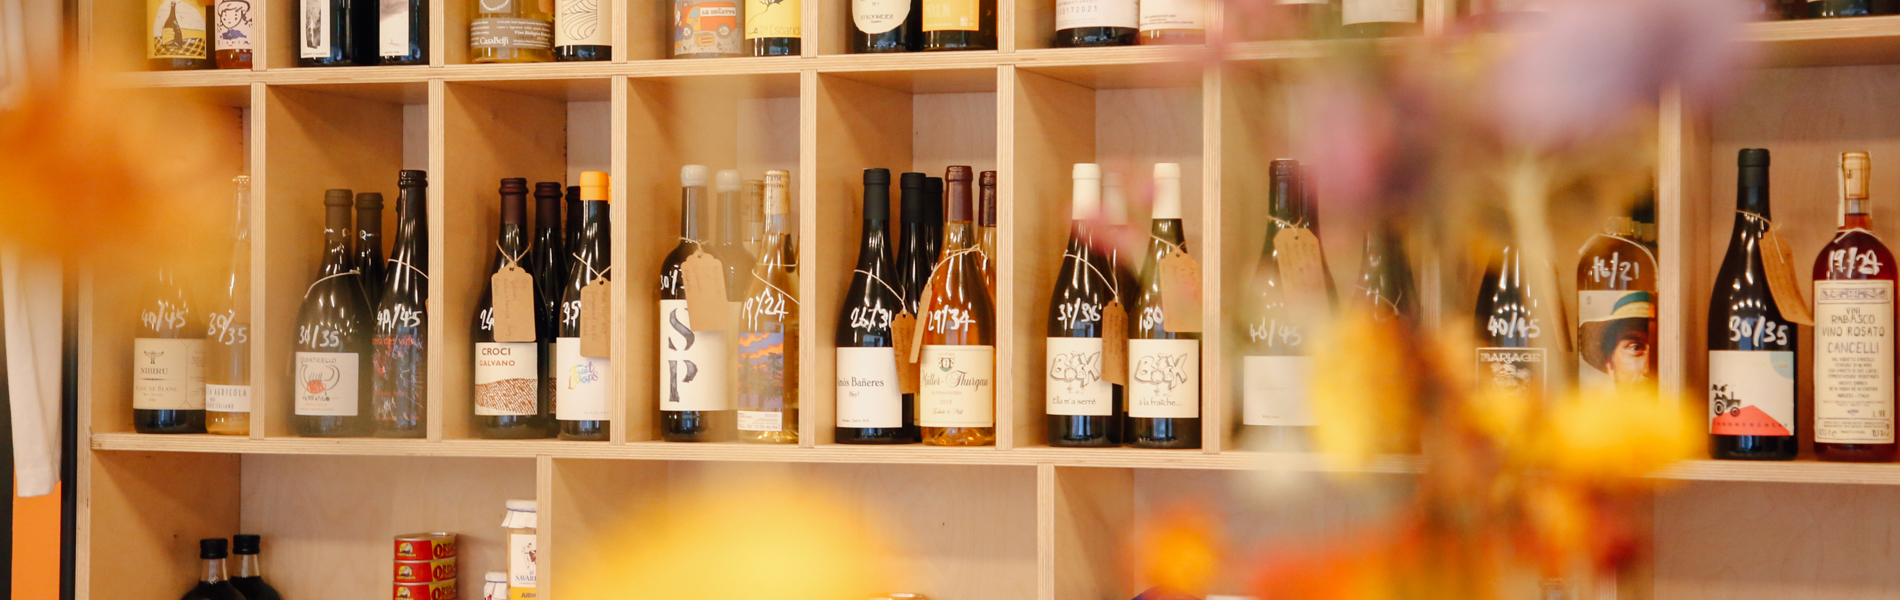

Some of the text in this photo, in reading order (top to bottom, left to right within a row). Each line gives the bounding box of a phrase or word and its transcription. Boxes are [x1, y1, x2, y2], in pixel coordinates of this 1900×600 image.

[770, 24, 801, 36] Escand
[1831, 314, 1875, 324] RABASCO
[1729, 315, 1788, 347] 30/35
[1822, 327, 1885, 337] VINO ROSATO
[1828, 342, 1879, 354] CANCELLI
[852, 377, 884, 386] Bañeres
